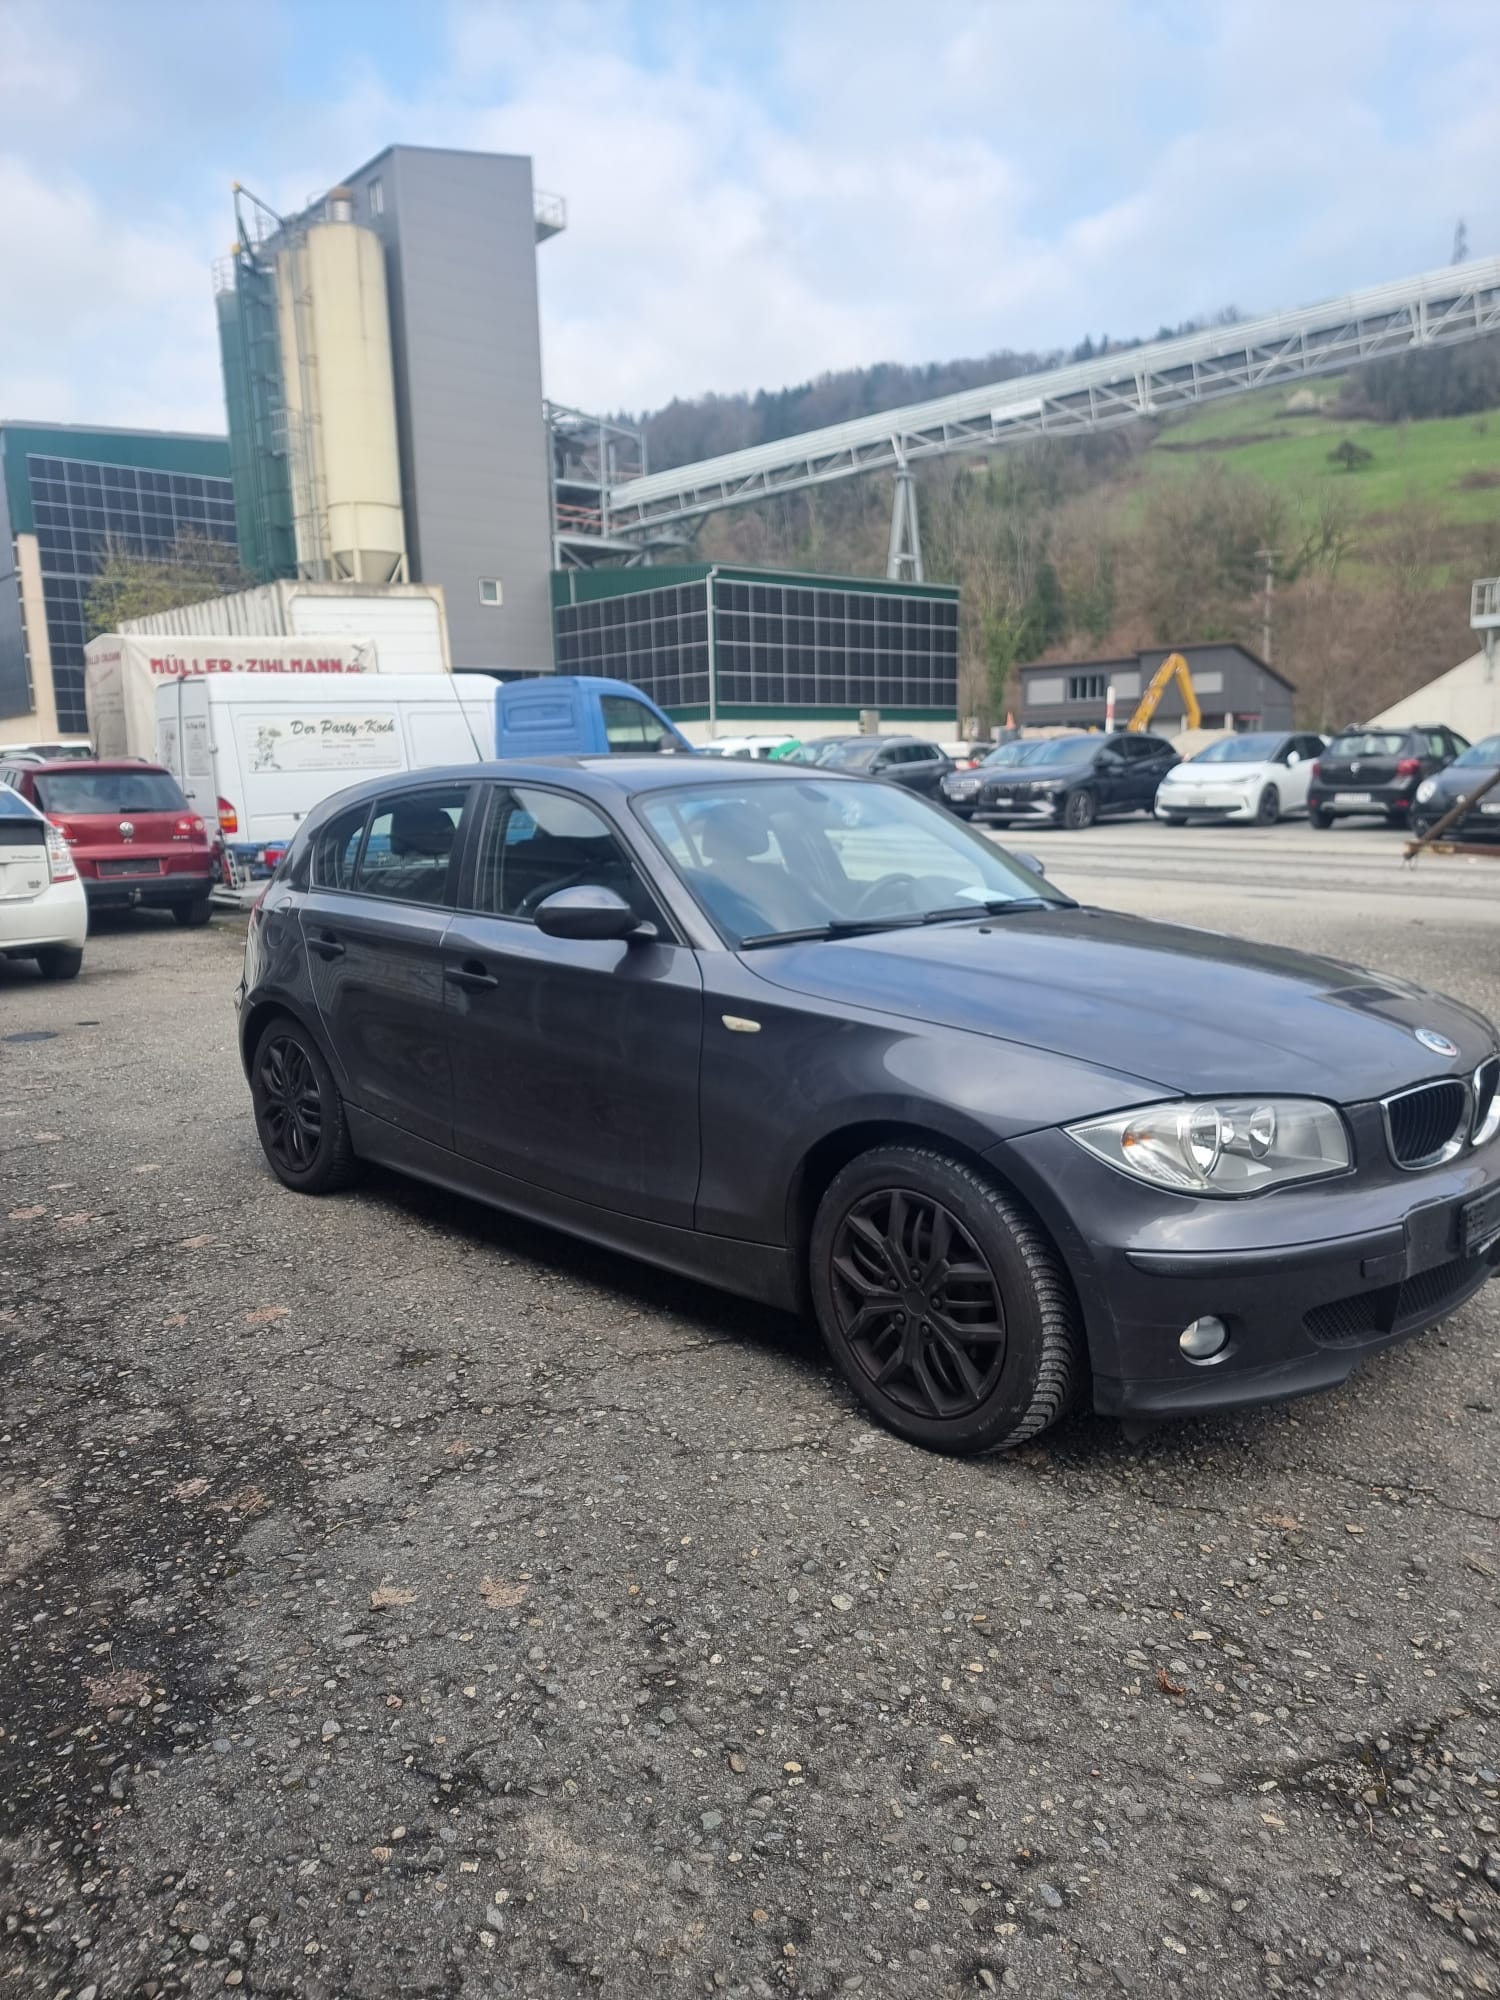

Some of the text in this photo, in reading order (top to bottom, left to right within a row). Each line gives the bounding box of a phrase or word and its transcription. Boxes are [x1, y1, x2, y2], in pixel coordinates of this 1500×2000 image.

[149, 653, 232, 675] MÜLLER
[245, 658, 342, 673] ZIHLMANN
[290, 719, 395, 736] Der Party-Koch
